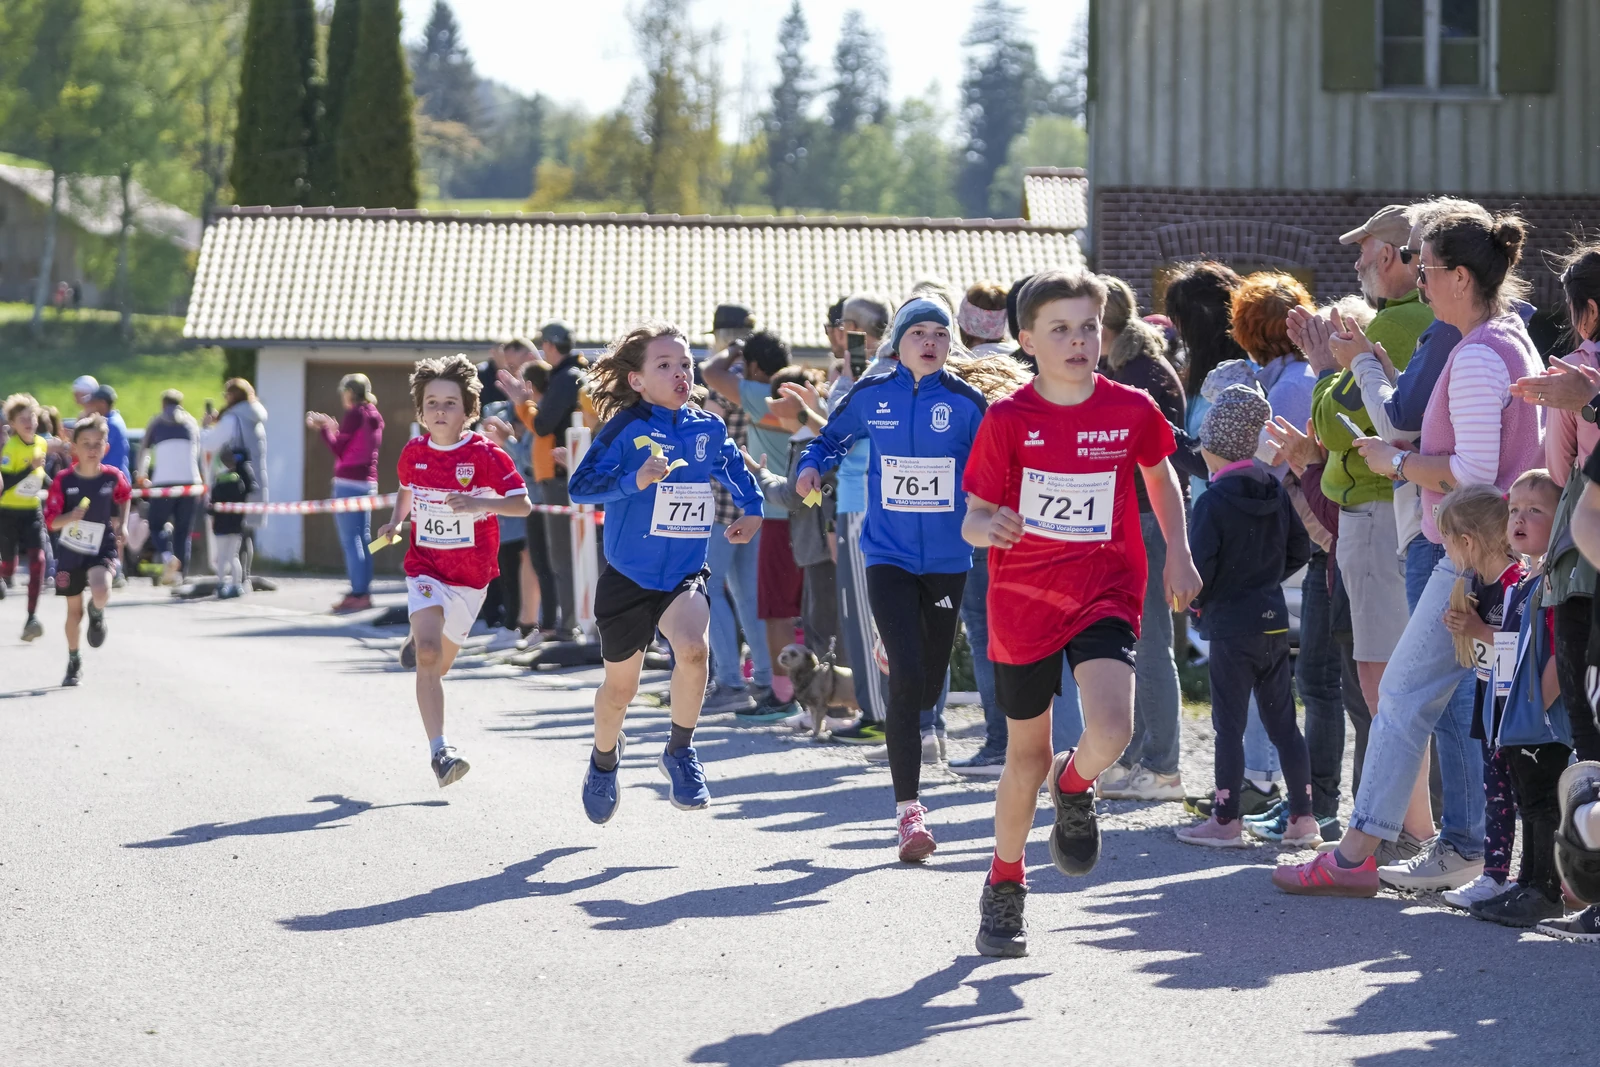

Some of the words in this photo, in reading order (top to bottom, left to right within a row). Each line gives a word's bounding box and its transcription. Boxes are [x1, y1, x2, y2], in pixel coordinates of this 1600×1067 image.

[1077, 429, 1129, 443] PFAFF
[894, 476, 938, 496] 76-1
[669, 502, 705, 521] 77-1
[1038, 494, 1094, 520] 72-1
[425, 518, 460, 535] 46-1
[1038, 521, 1055, 529] VBAO
[1056, 524, 1094, 532] Voralpencup
